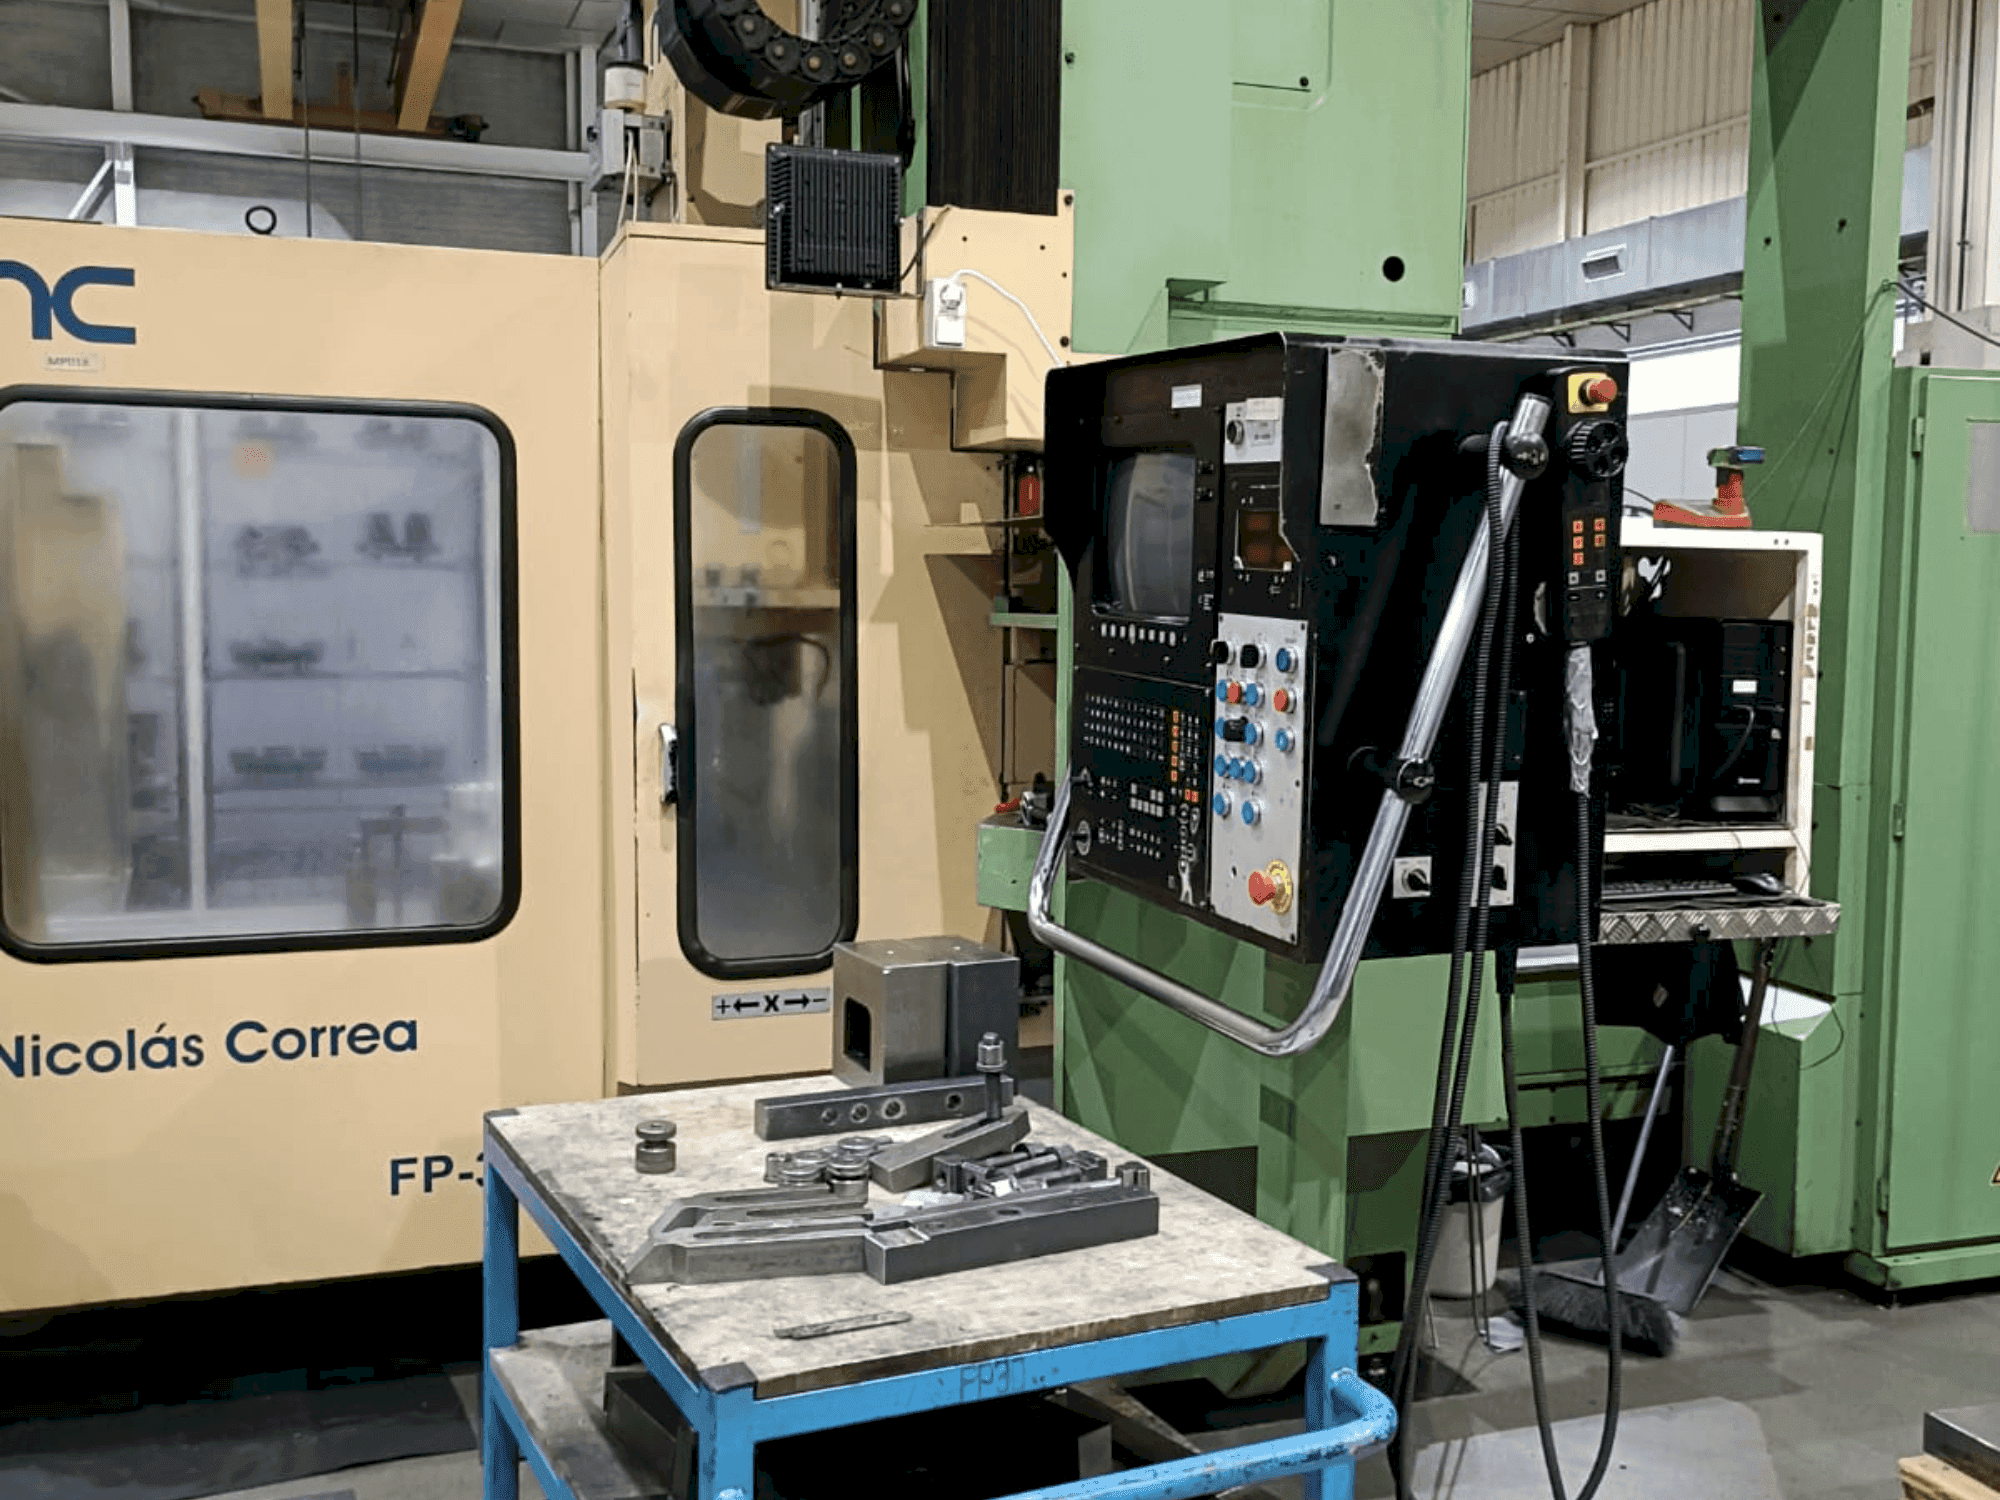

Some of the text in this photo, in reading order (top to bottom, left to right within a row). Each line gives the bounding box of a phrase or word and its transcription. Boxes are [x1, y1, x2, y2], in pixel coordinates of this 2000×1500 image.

[763, 994, 779, 1012] X
[0, 1020, 418, 1078] Nicolás Correa
